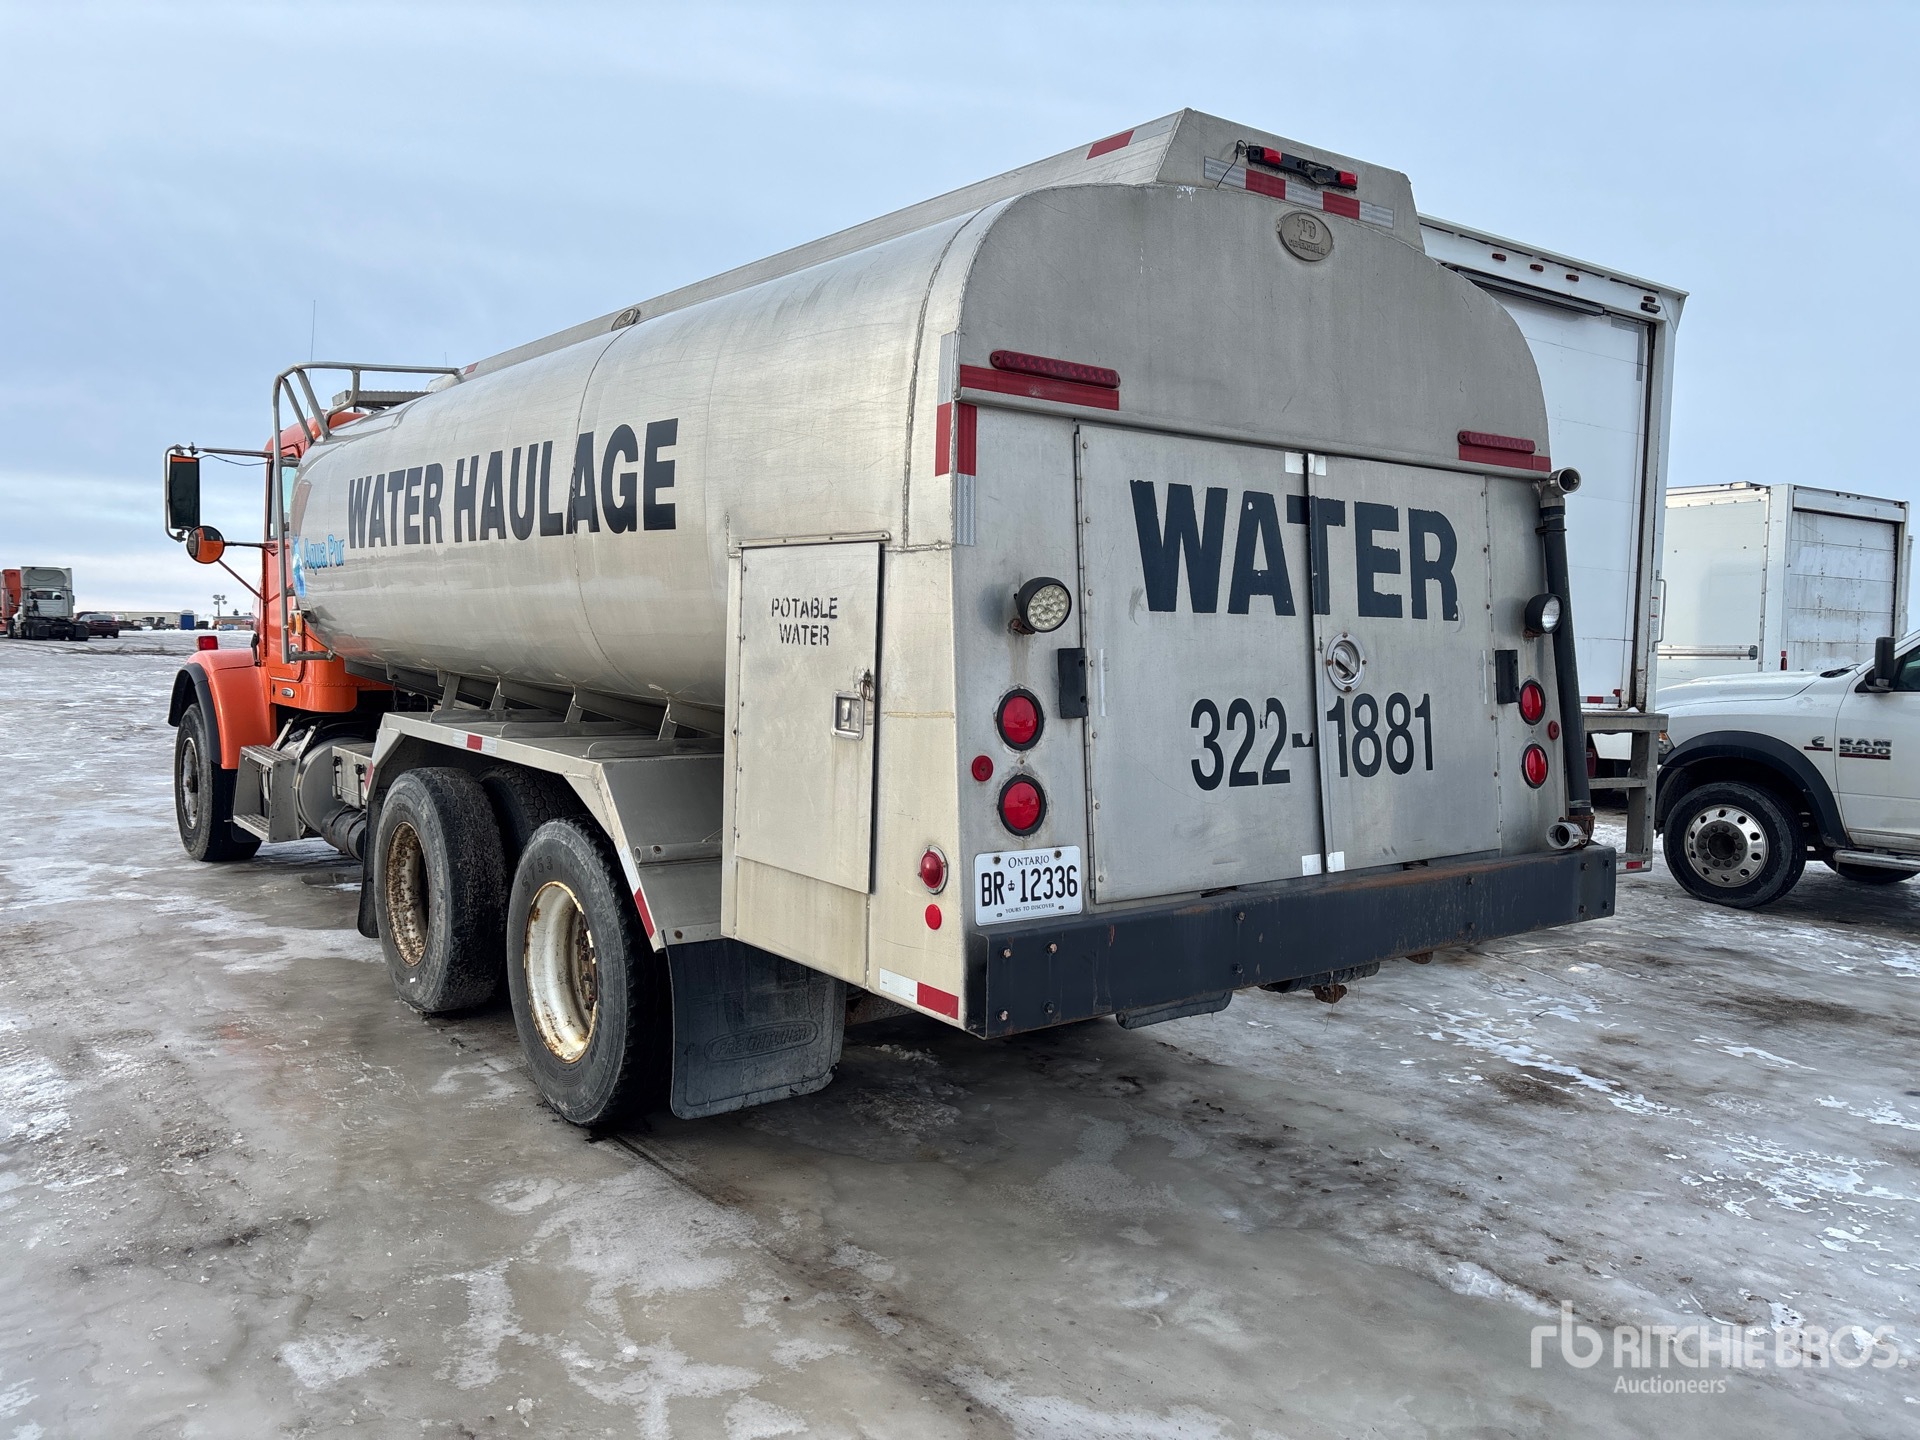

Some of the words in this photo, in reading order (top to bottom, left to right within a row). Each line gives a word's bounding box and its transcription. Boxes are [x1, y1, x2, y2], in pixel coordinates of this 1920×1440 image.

[347, 462, 444, 549] WATER
[454, 417, 679, 543] HAULAGE
[304, 537, 327, 576] Aqua
[1129, 479, 1459, 621] WATER
[771, 597, 838, 619] POTABLE
[779, 623, 829, 646] WATER
[1190, 692, 1434, 791] 322-1881
[1839, 737, 1892, 748] RAM
[1839, 746, 1891, 755] 5500
[981, 871, 1005, 907] BR
[1020, 865, 1078, 902] 12336
[1005, 906, 1022, 914] YOURS
